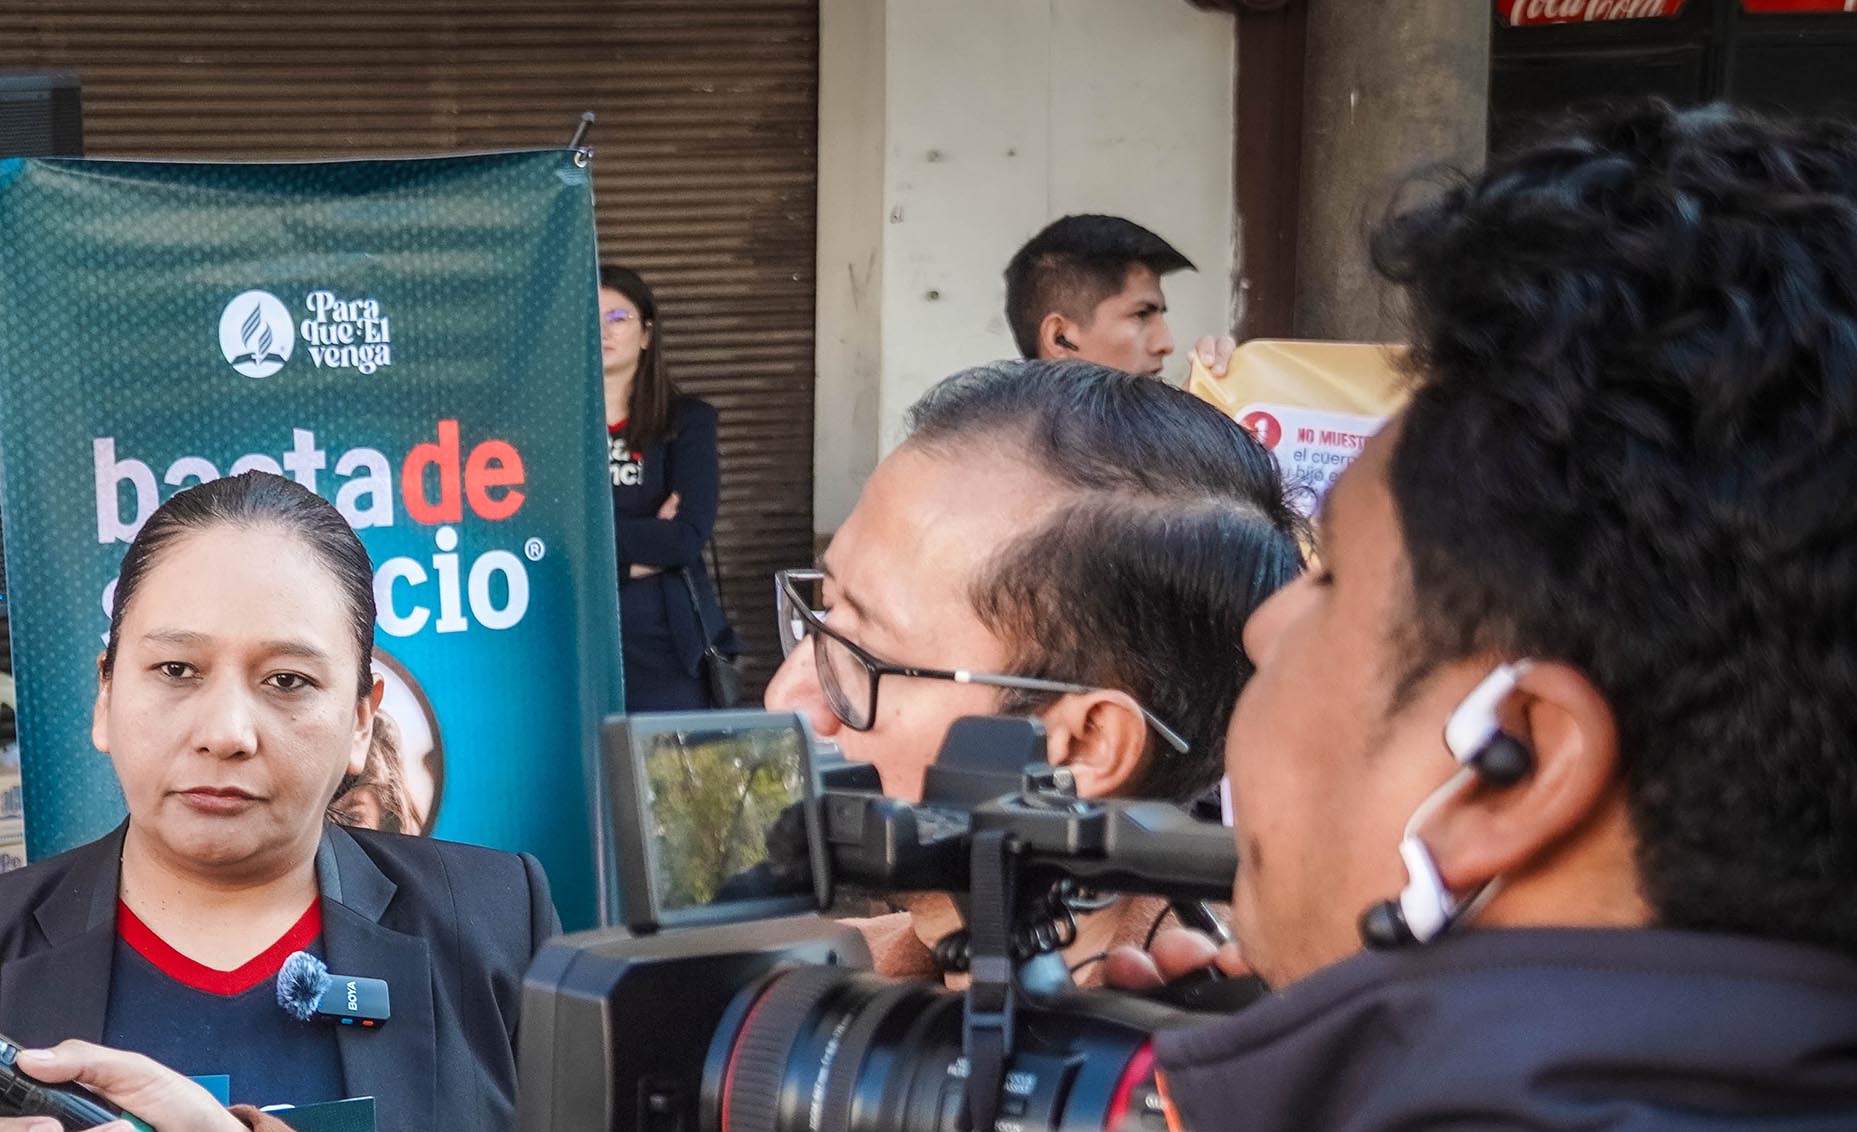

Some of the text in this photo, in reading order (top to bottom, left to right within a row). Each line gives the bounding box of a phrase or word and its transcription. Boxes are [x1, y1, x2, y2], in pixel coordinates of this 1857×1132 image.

[305, 290, 381, 323] Para
[300, 317, 391, 346] que El
[308, 342, 392, 374] venga
[1296, 427, 1315, 444] NO
[1293, 447, 1308, 461] el
[346, 981, 358, 1011] BOYA
